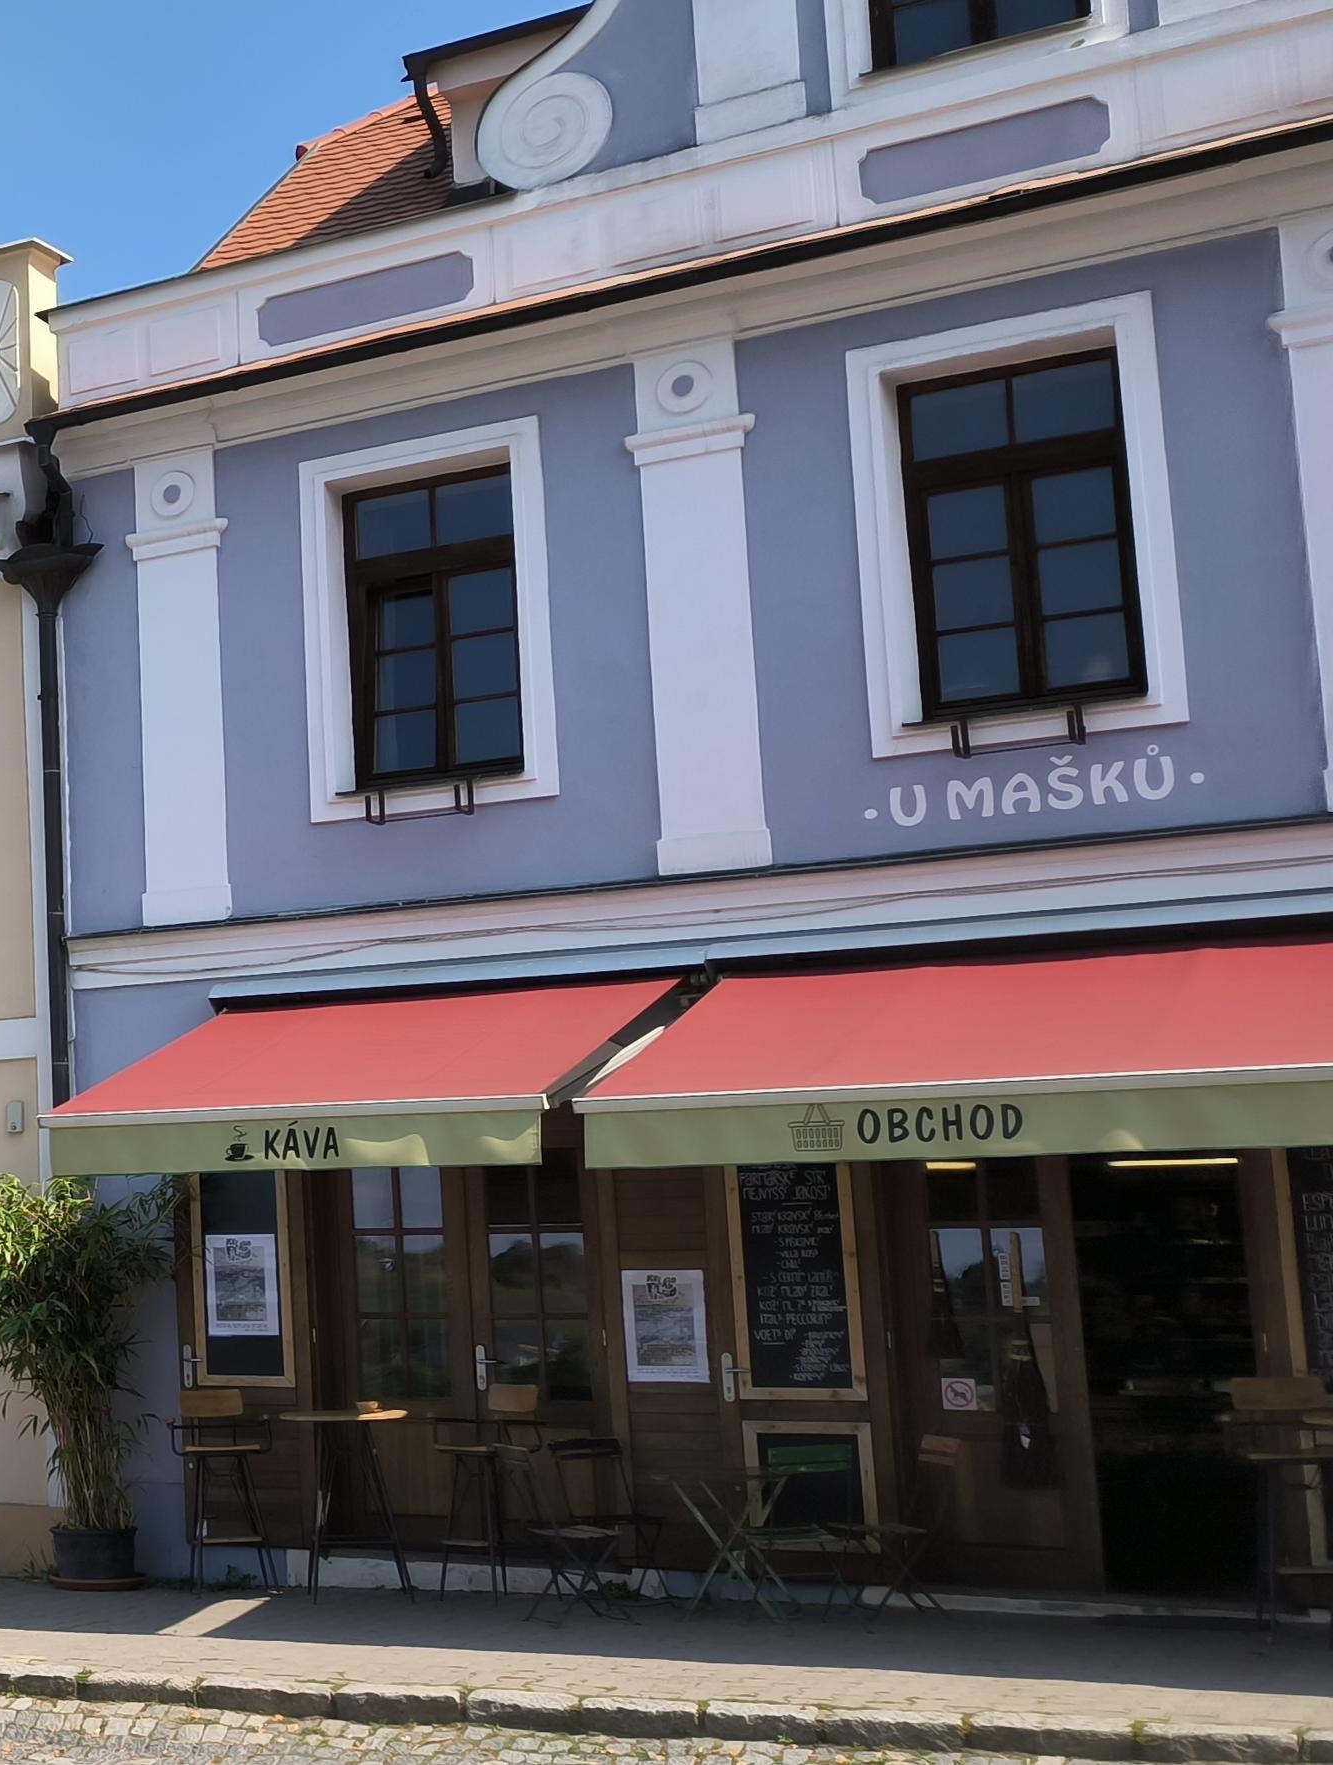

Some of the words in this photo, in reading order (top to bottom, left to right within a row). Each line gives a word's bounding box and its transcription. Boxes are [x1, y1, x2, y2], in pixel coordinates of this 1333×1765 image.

[889, 784, 927, 827] U
[946, 744, 1175, 821] MAŠKŮ
[264, 1120, 340, 1160] KÁVA
[857, 1103, 1023, 1144] OBCHOD
